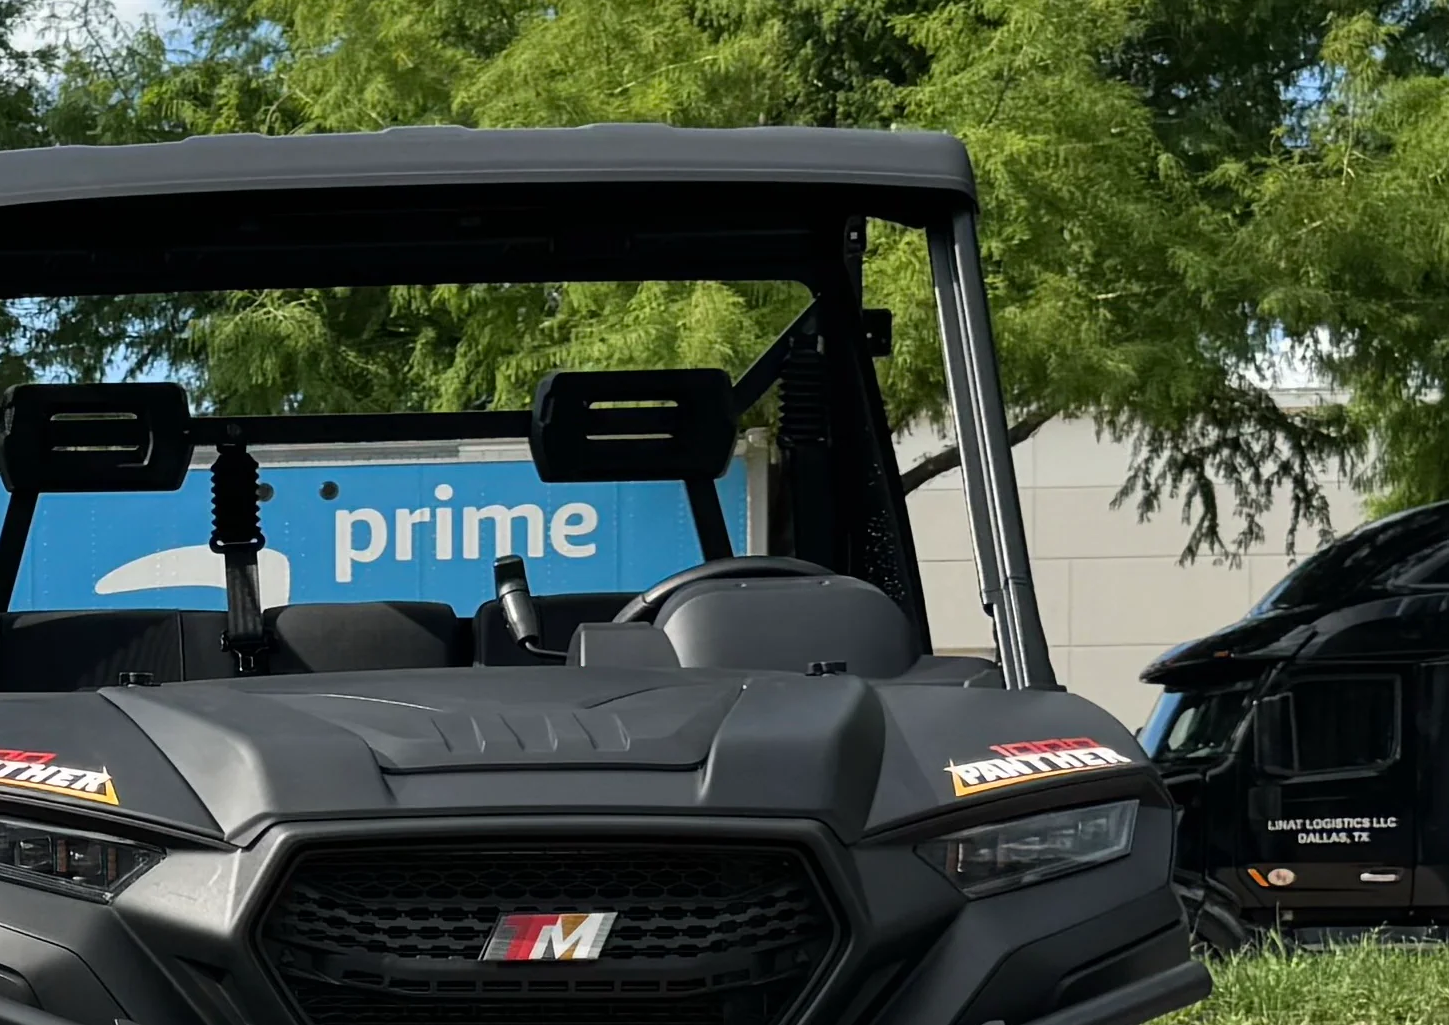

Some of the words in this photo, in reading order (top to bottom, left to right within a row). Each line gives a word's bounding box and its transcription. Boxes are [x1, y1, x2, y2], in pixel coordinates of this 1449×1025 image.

[335, 484, 598, 583] prime
[989, 736, 1102, 758] 1000
[955, 746, 1133, 786] PANTHER
[1267, 819, 1303, 830] LINAT
[1305, 817, 1370, 829] LOGISTICS
[1372, 816, 1398, 828] LLC
[1297, 832, 1351, 844] DALLAS,
[1353, 831, 1371, 842] TX
[502, 912, 607, 961] TM
